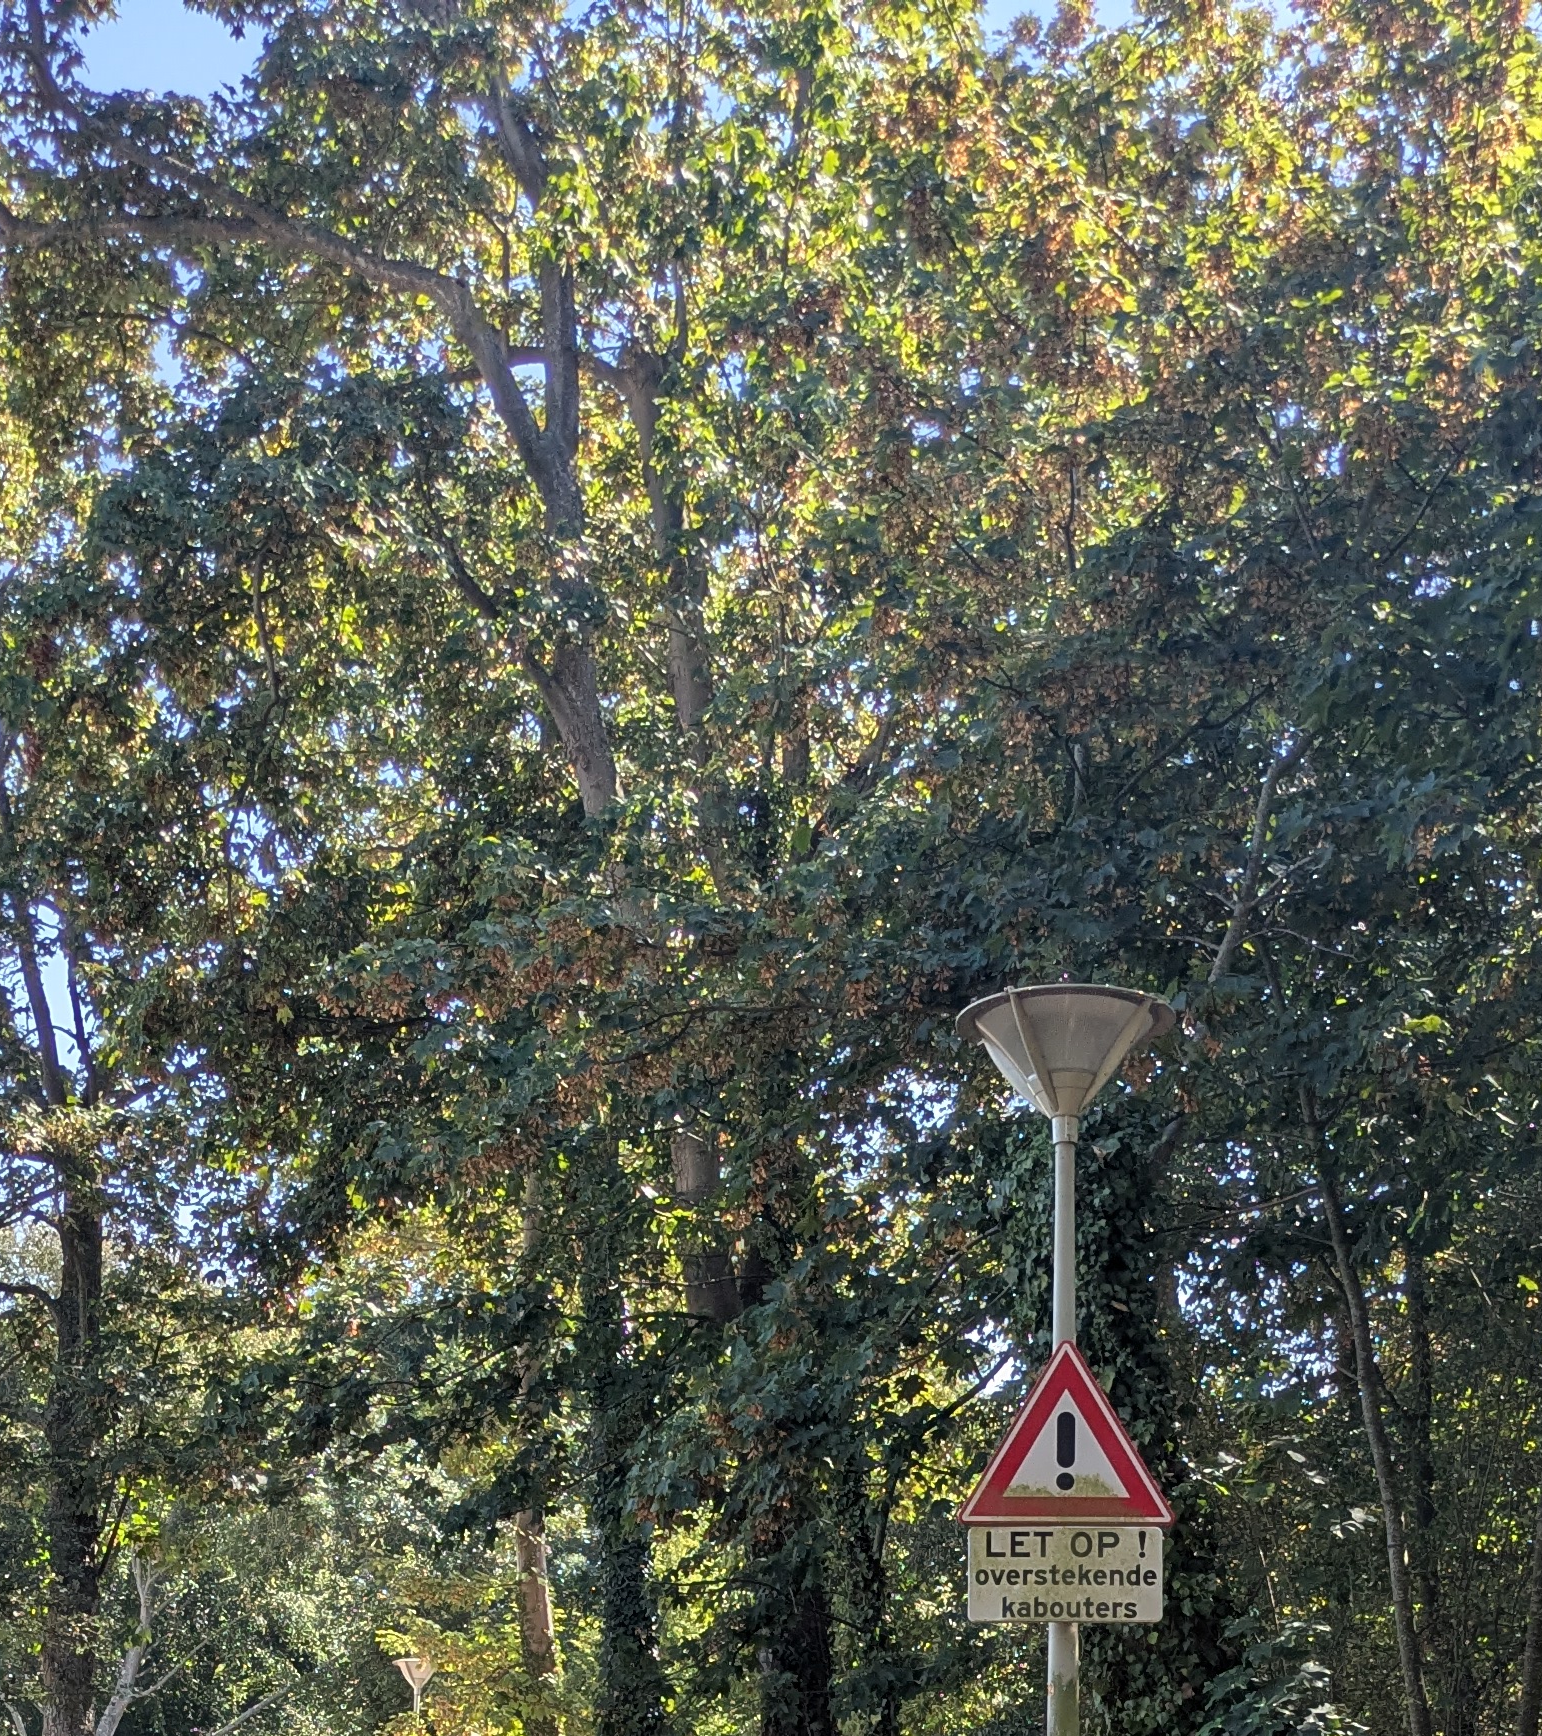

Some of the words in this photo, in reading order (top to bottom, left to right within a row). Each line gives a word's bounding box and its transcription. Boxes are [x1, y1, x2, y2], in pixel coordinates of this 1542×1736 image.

[985, 1531, 1053, 1558] LET
[1070, 1531, 1120, 1558] OP
[975, 1564, 1157, 1586] overstekende
[1002, 1597, 1138, 1618] kabouters
